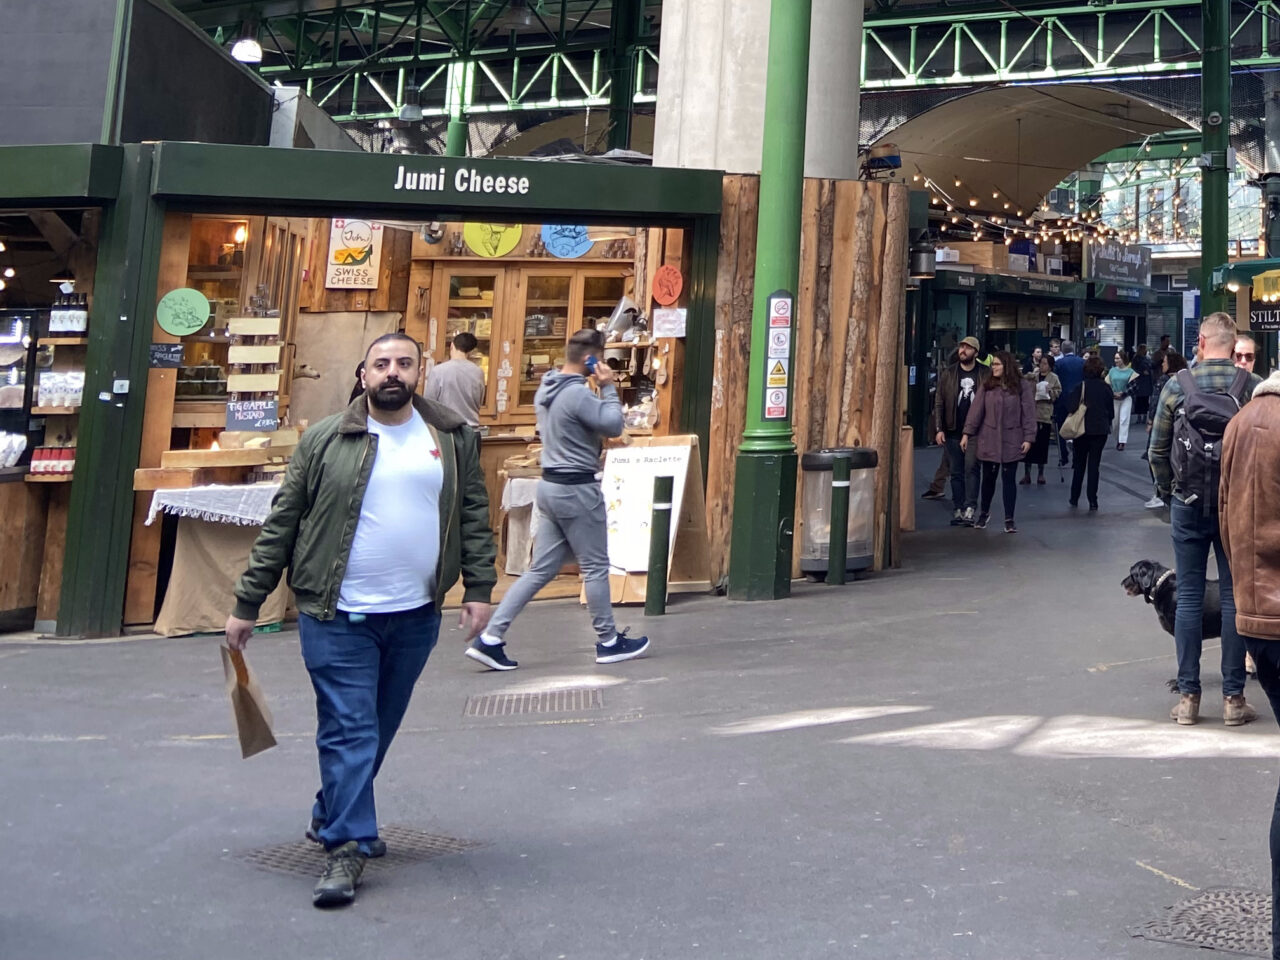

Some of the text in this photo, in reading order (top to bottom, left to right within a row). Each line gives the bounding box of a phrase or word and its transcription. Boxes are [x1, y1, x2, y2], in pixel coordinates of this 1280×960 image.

[394, 166, 529, 194] Jumi Cheese
[334, 268, 368, 277] SWISS
[330, 276, 374, 286] CHEESE
[249, 401, 275, 410] APPLE
